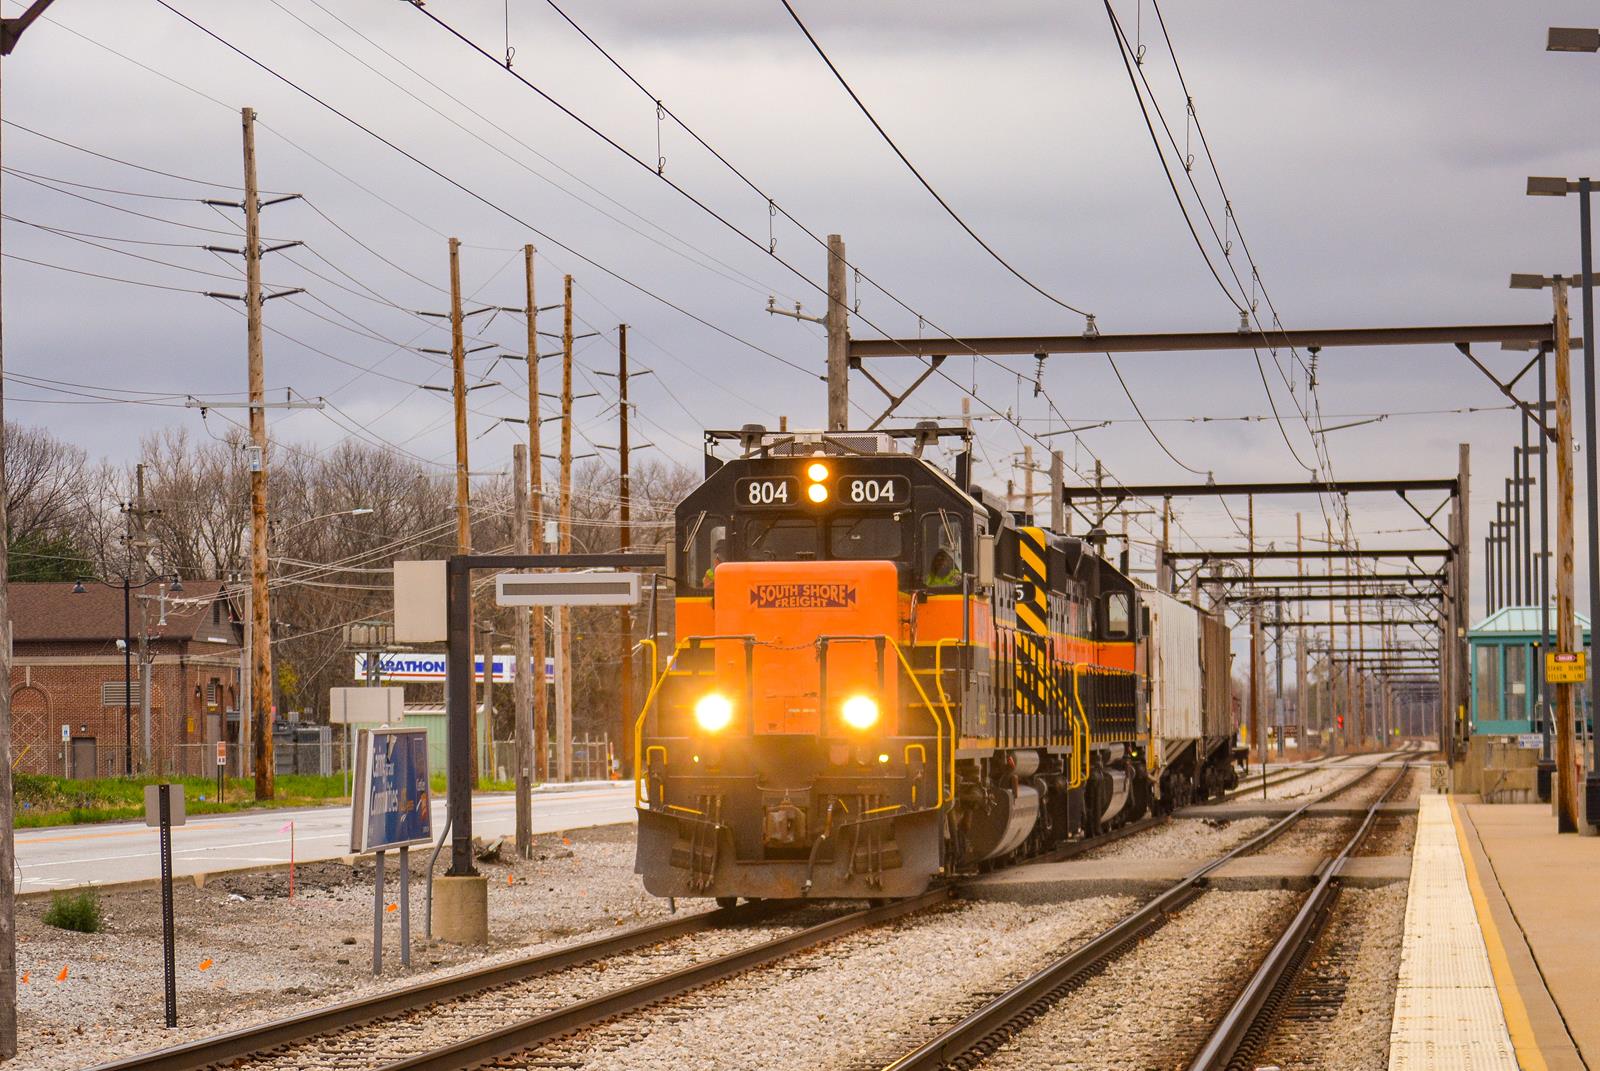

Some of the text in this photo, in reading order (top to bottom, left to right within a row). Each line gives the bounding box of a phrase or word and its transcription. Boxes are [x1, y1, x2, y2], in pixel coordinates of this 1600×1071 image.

[749, 481, 787, 504] 804
[851, 480, 894, 502] 804
[759, 585, 846, 605] SOUTH SHORE
[775, 596, 828, 608] FREIGHT
